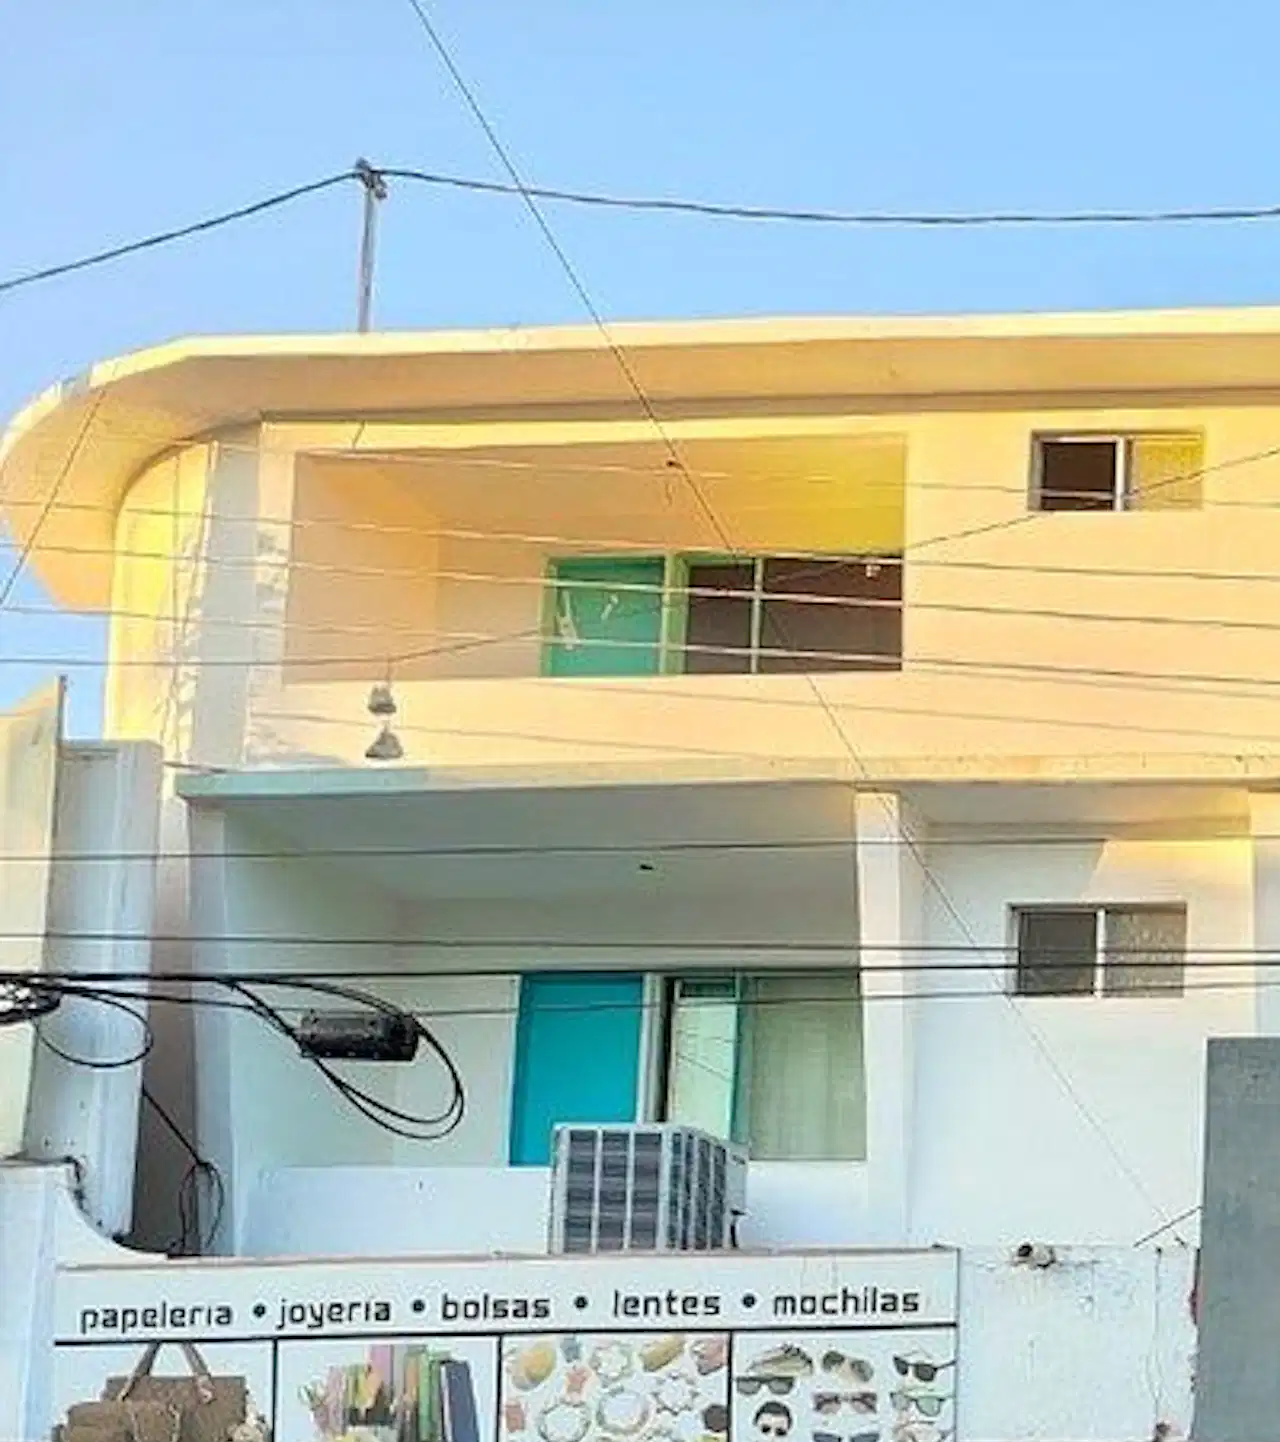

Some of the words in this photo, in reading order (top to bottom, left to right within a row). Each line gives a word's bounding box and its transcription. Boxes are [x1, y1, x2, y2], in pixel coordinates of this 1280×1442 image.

[441, 1293, 551, 1320] bolsas
[613, 1289, 720, 1317] lentes
[773, 1286, 920, 1317] mochilas
